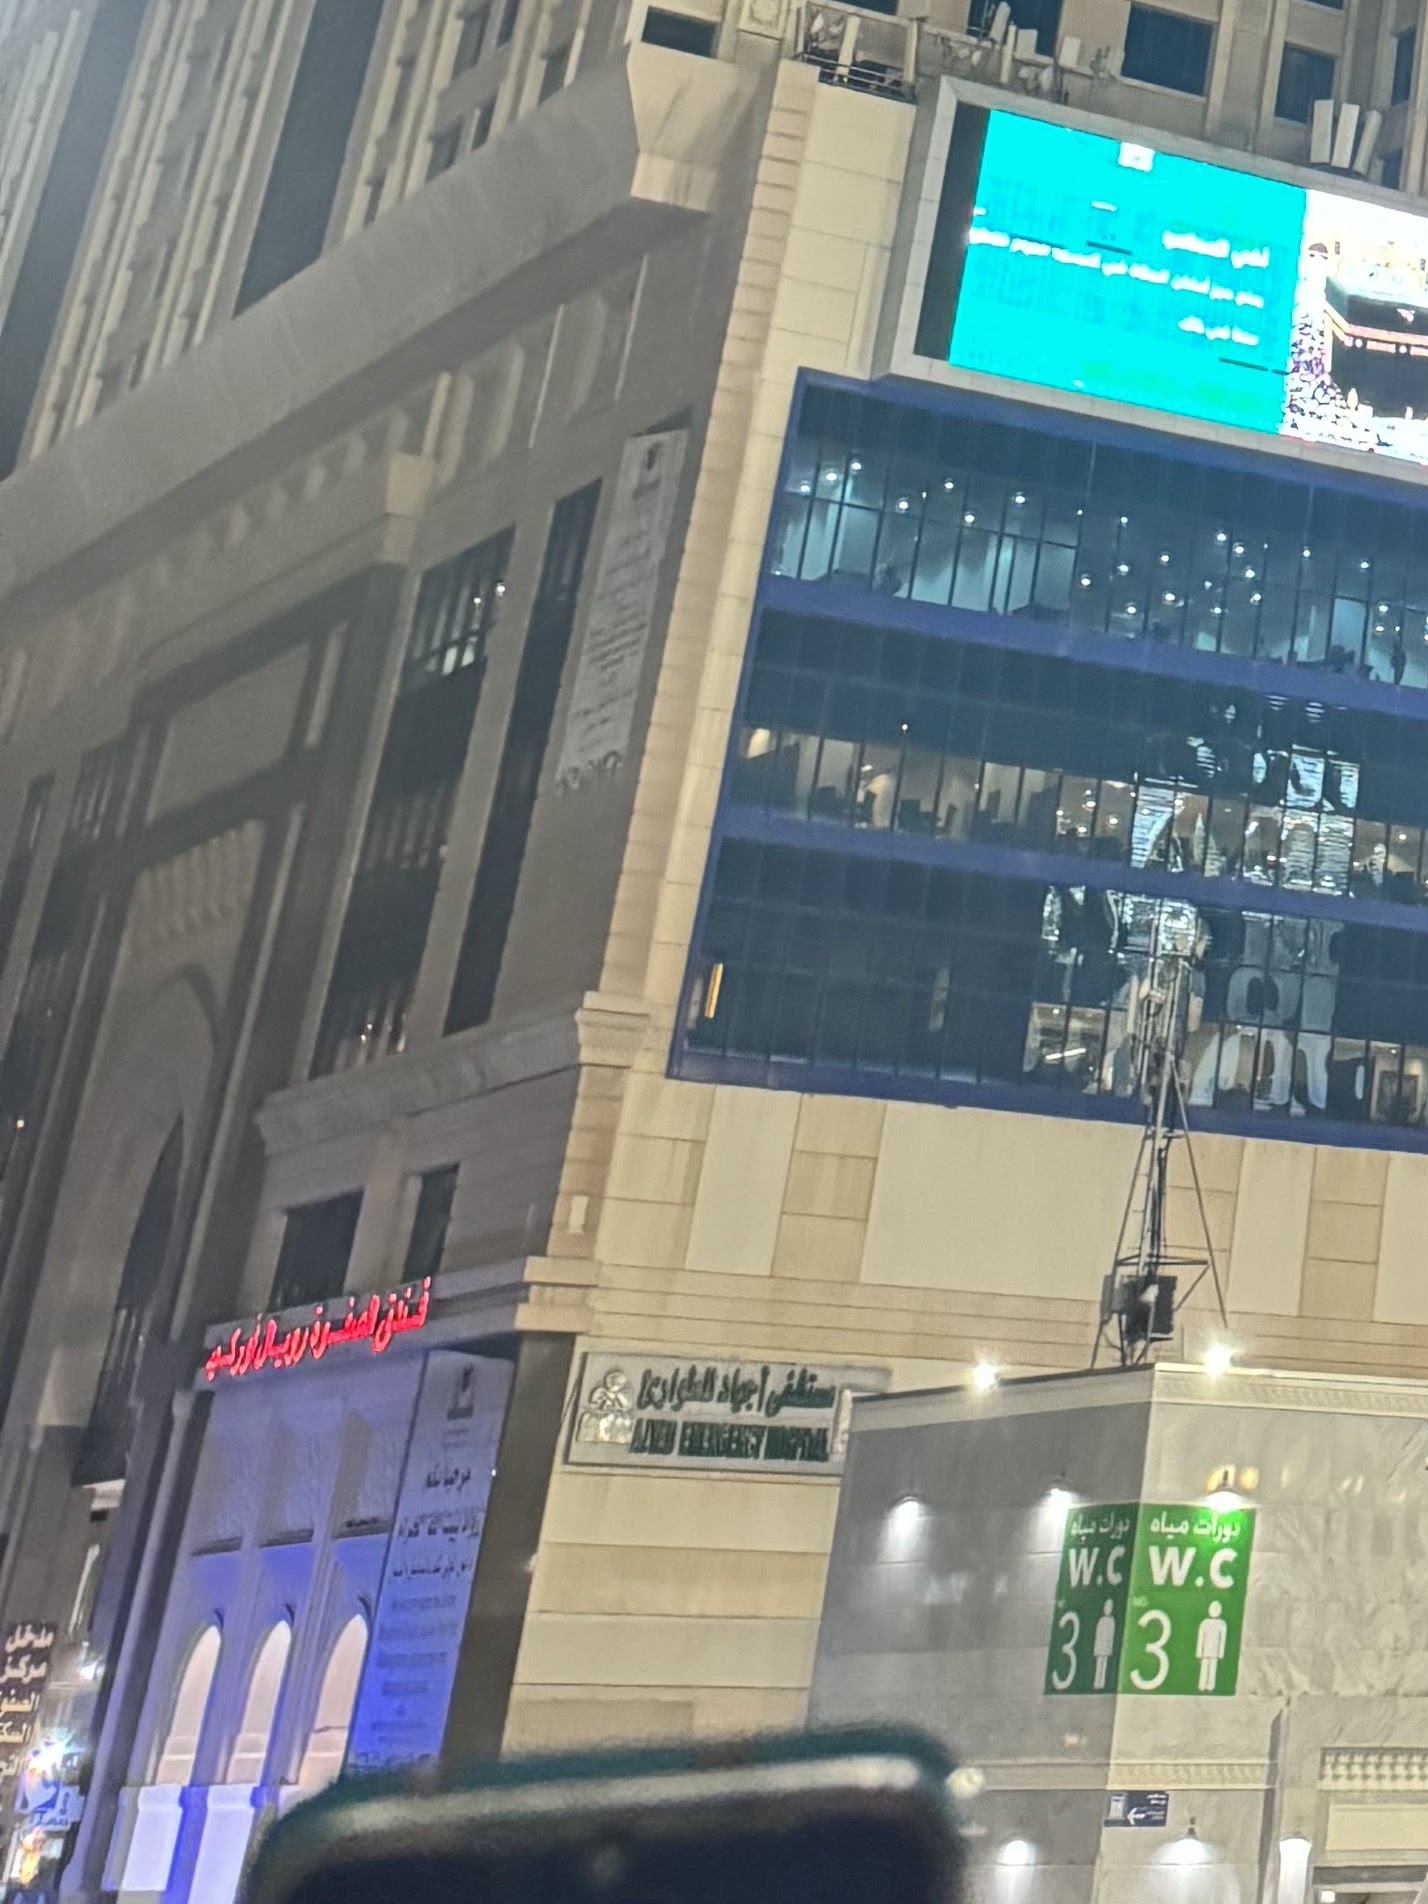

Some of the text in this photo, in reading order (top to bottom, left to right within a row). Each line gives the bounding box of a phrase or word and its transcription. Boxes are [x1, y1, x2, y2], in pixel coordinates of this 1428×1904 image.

[372, 1275, 432, 1352] فندق
[1070, 1511, 1131, 1541] دورات مياه
[1150, 1510, 1242, 1544] دورات مياه
[1068, 1545, 1126, 1587] W.C
[1149, 1545, 1238, 1589] W.C
[4, 1621, 55, 1654] مدخل
[1052, 1610, 1081, 1690] 3
[1130, 1608, 1172, 1690] 3
[0, 1688, 40, 1717] الصفو
